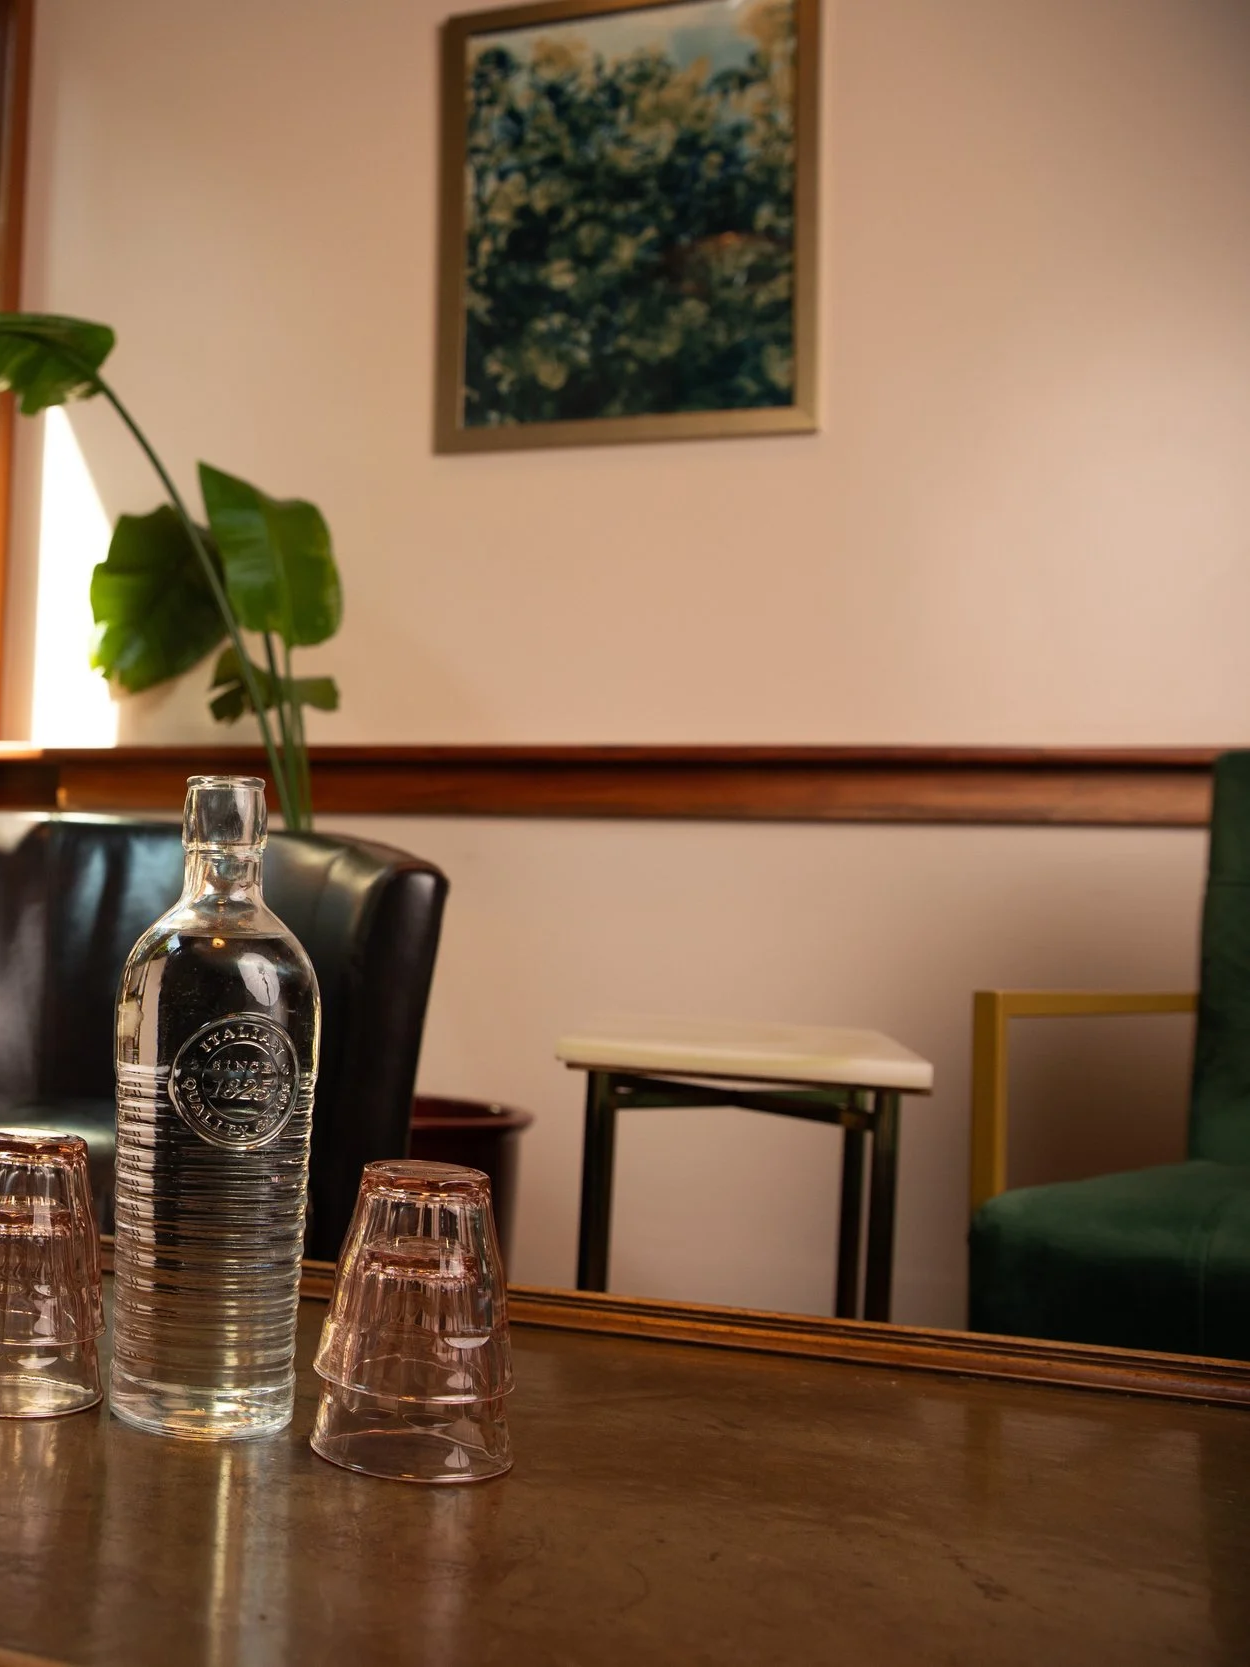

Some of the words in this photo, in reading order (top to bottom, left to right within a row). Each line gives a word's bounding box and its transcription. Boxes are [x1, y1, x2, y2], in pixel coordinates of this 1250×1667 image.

[200, 1025, 285, 1056] ITALIAN
[212, 1060, 273, 1074] SINCE
[207, 1078, 275, 1101] 1825
[181, 1076, 249, 1138] QUALITY
